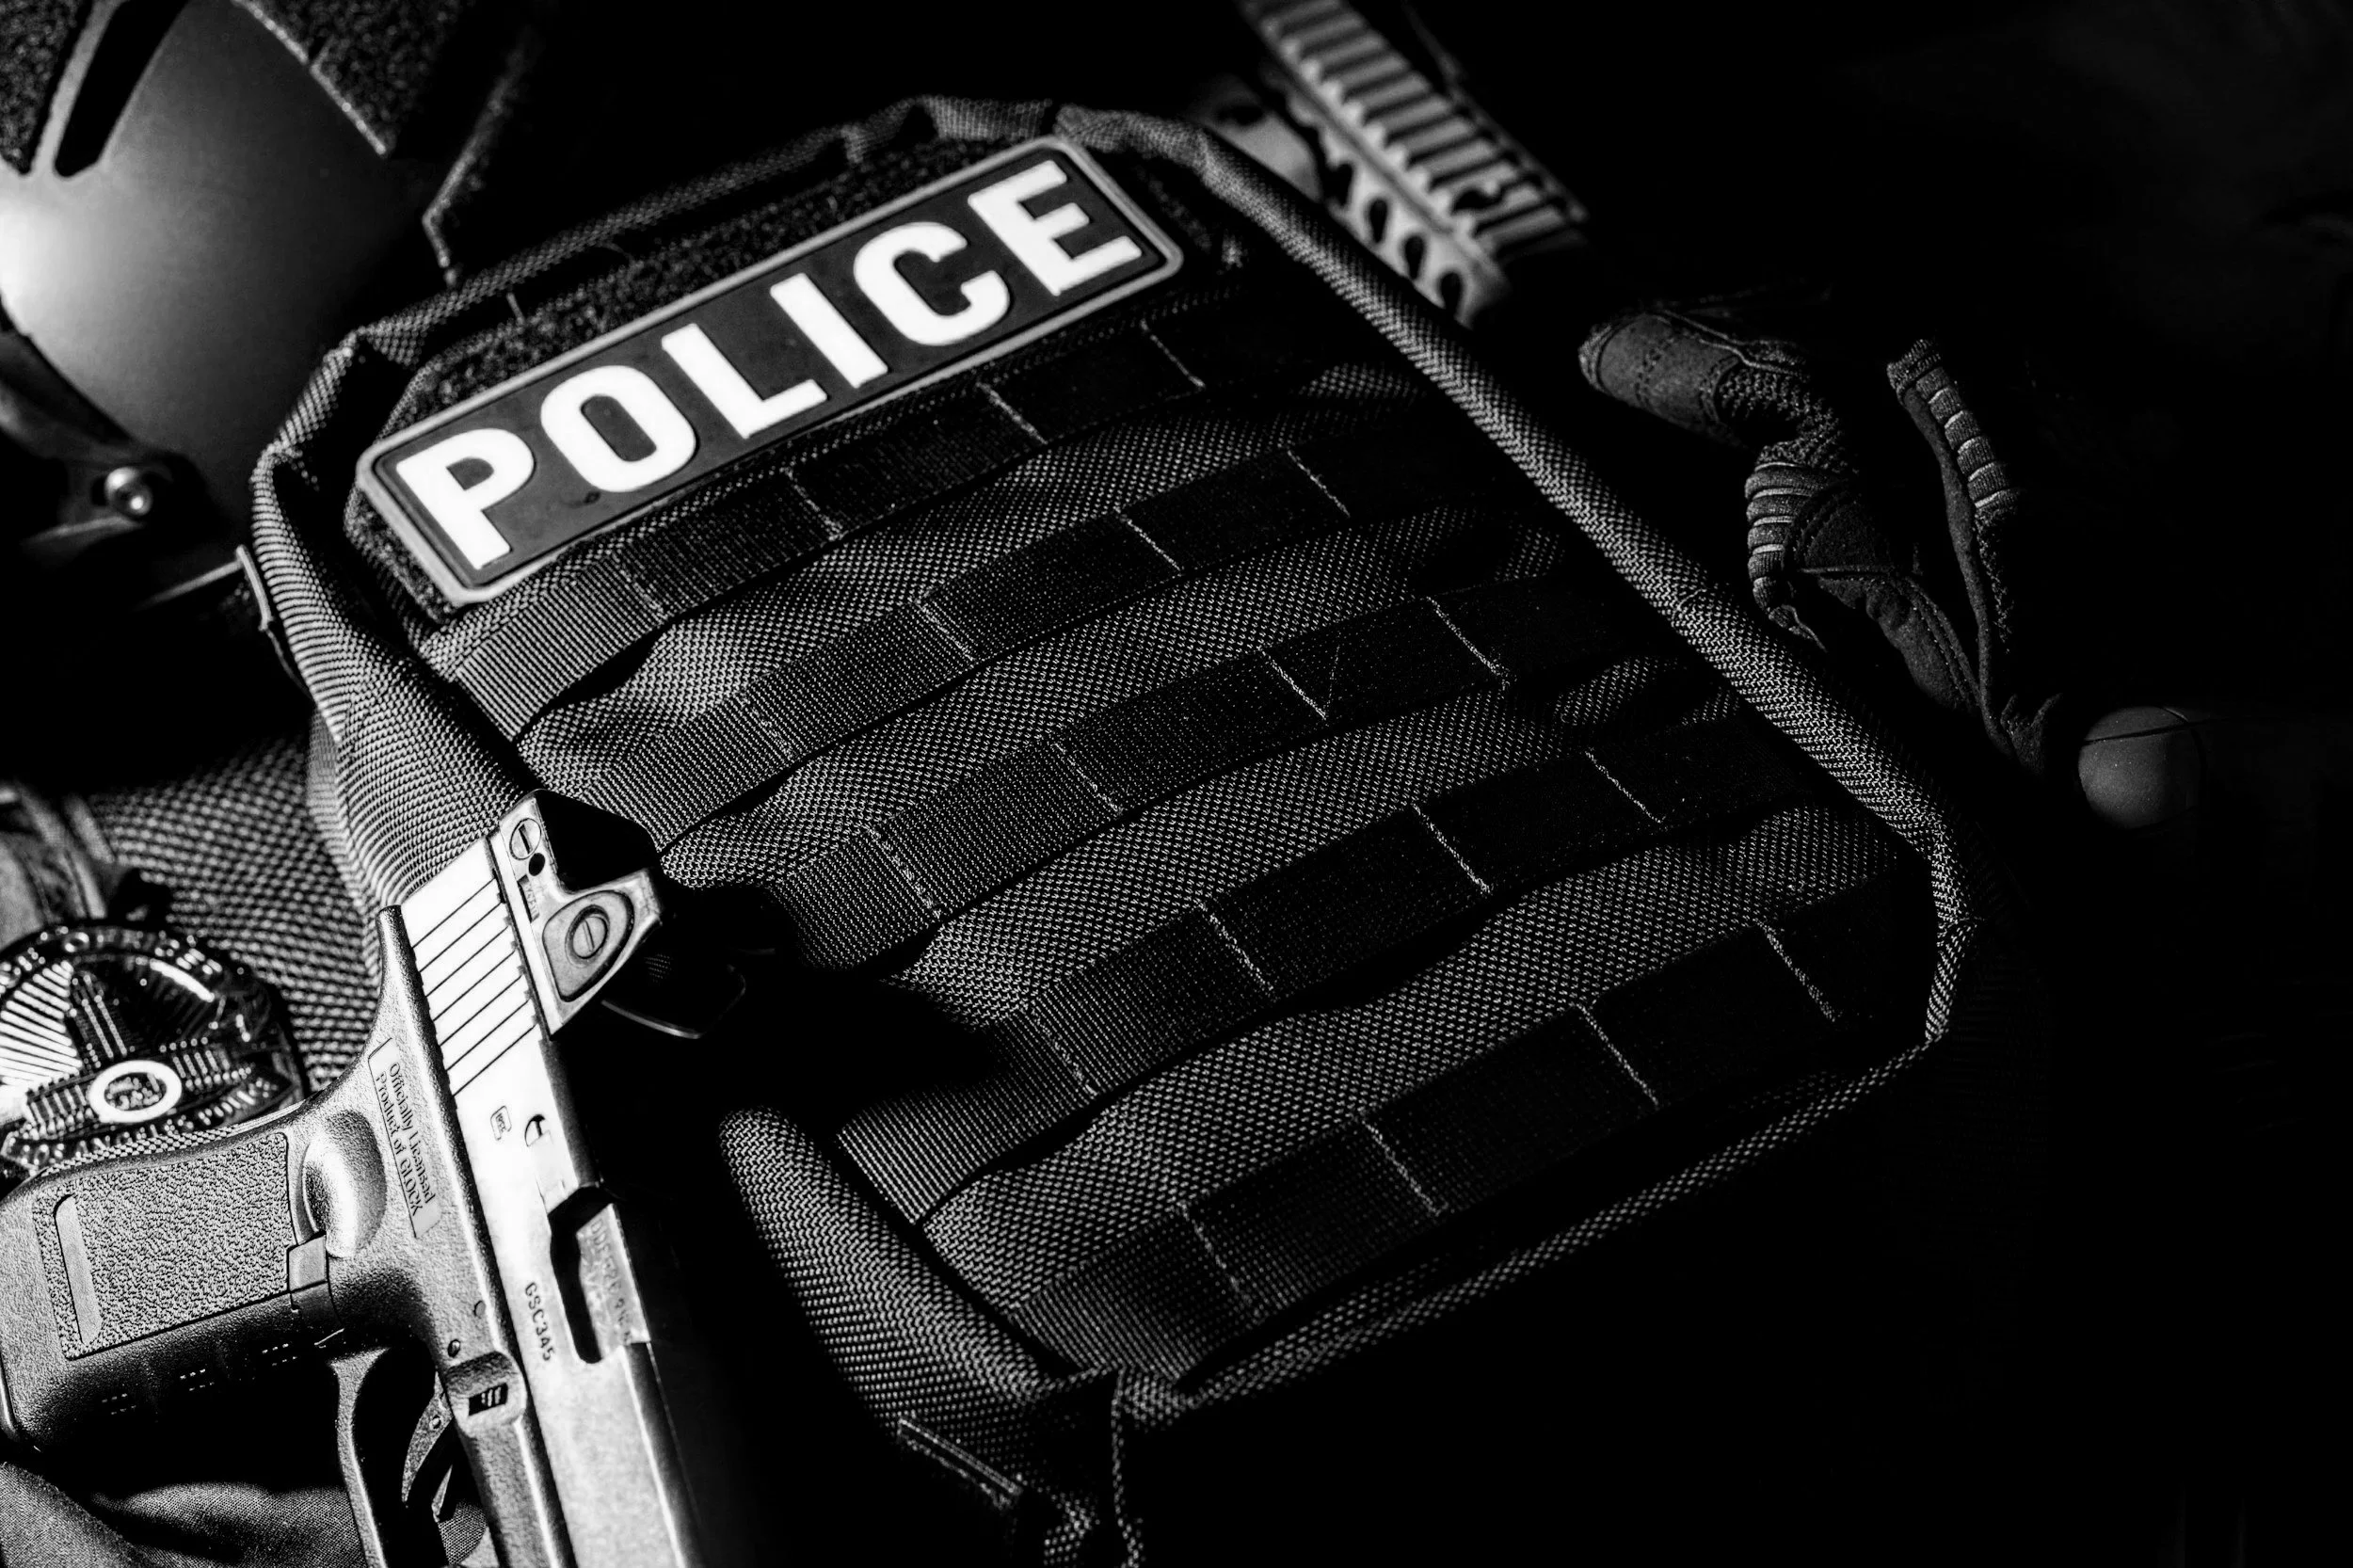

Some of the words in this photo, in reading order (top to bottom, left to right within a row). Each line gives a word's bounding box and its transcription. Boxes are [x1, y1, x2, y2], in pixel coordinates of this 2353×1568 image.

[396, 160, 1142, 569] POLICE
[376, 1071, 400, 1137] Product
[390, 1062, 414, 1130] Officially
[408, 1131, 436, 1204] Licensed
[394, 1138, 407, 1155] of
[400, 1158, 424, 1216] GLOCK
[524, 1282, 555, 1361] GSC345
